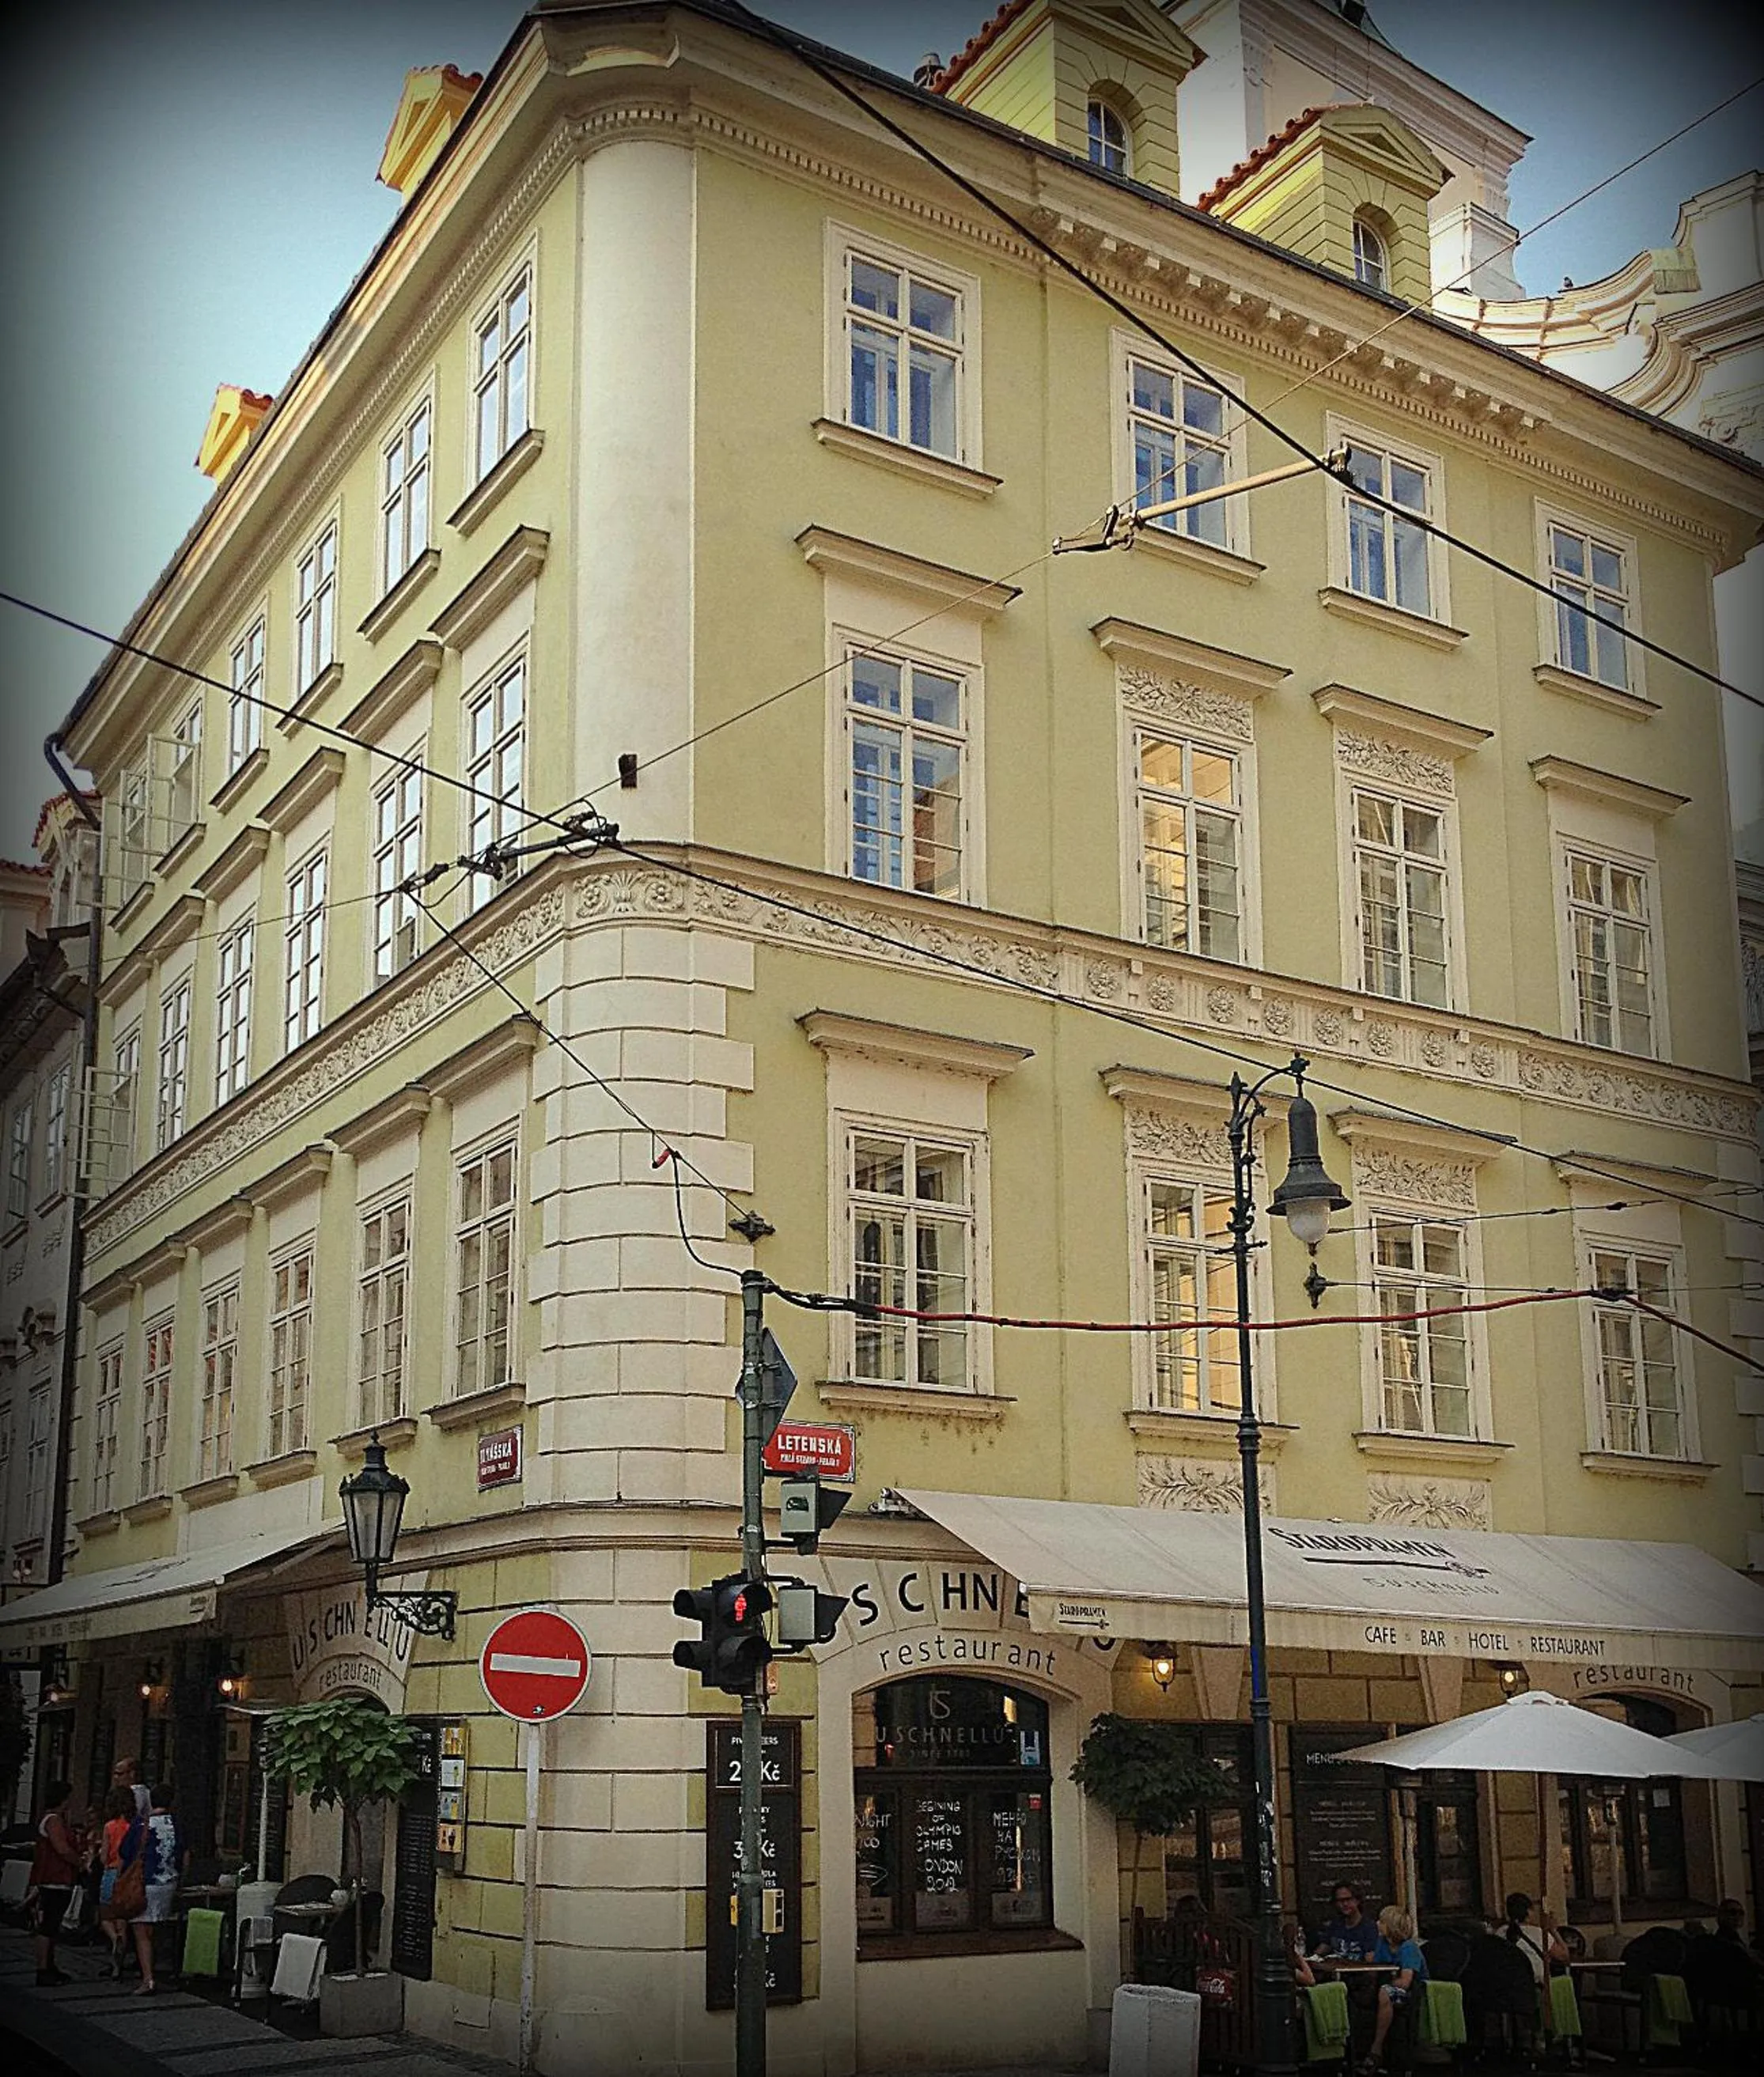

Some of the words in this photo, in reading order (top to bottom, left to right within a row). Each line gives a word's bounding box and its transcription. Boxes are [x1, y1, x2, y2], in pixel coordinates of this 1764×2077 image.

[778, 1434, 842, 1455] LETENSKÁ
[1365, 1626, 1397, 1644] CAFE
[1421, 1629, 1445, 1647] BAR
[1468, 1632, 1509, 1651] HOTEL
[1530, 1636, 1605, 1656] RESTAURANT
[879, 1634, 1057, 1676] restaurant
[319, 1660, 382, 1693] restaurant
[729, 1761, 742, 1782] 2
[761, 1761, 782, 1782] Kč
[761, 1840, 777, 1858] Kč
[915, 1837, 954, 1852] GAMES
[926, 1875, 960, 1893] 2012
